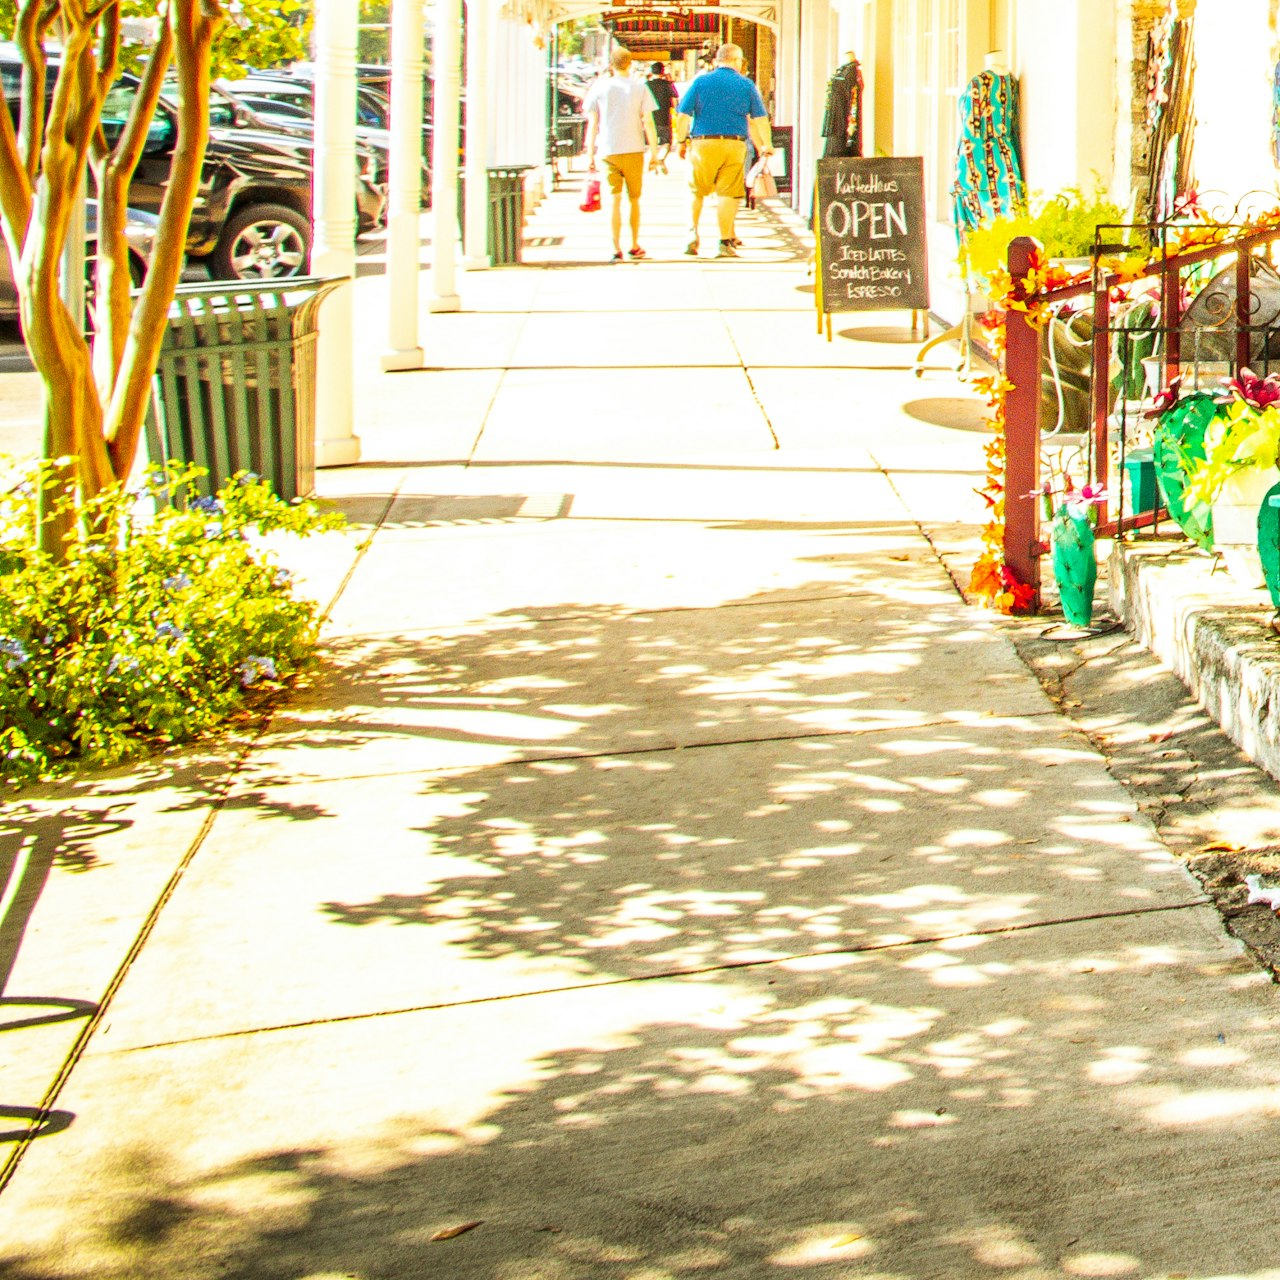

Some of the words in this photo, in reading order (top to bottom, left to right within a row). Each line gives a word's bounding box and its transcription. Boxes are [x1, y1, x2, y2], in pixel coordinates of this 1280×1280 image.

[825, 200, 909, 240] OPEN
[871, 266, 912, 285] Bakery
[847, 282, 902, 299] ESPRESSO
